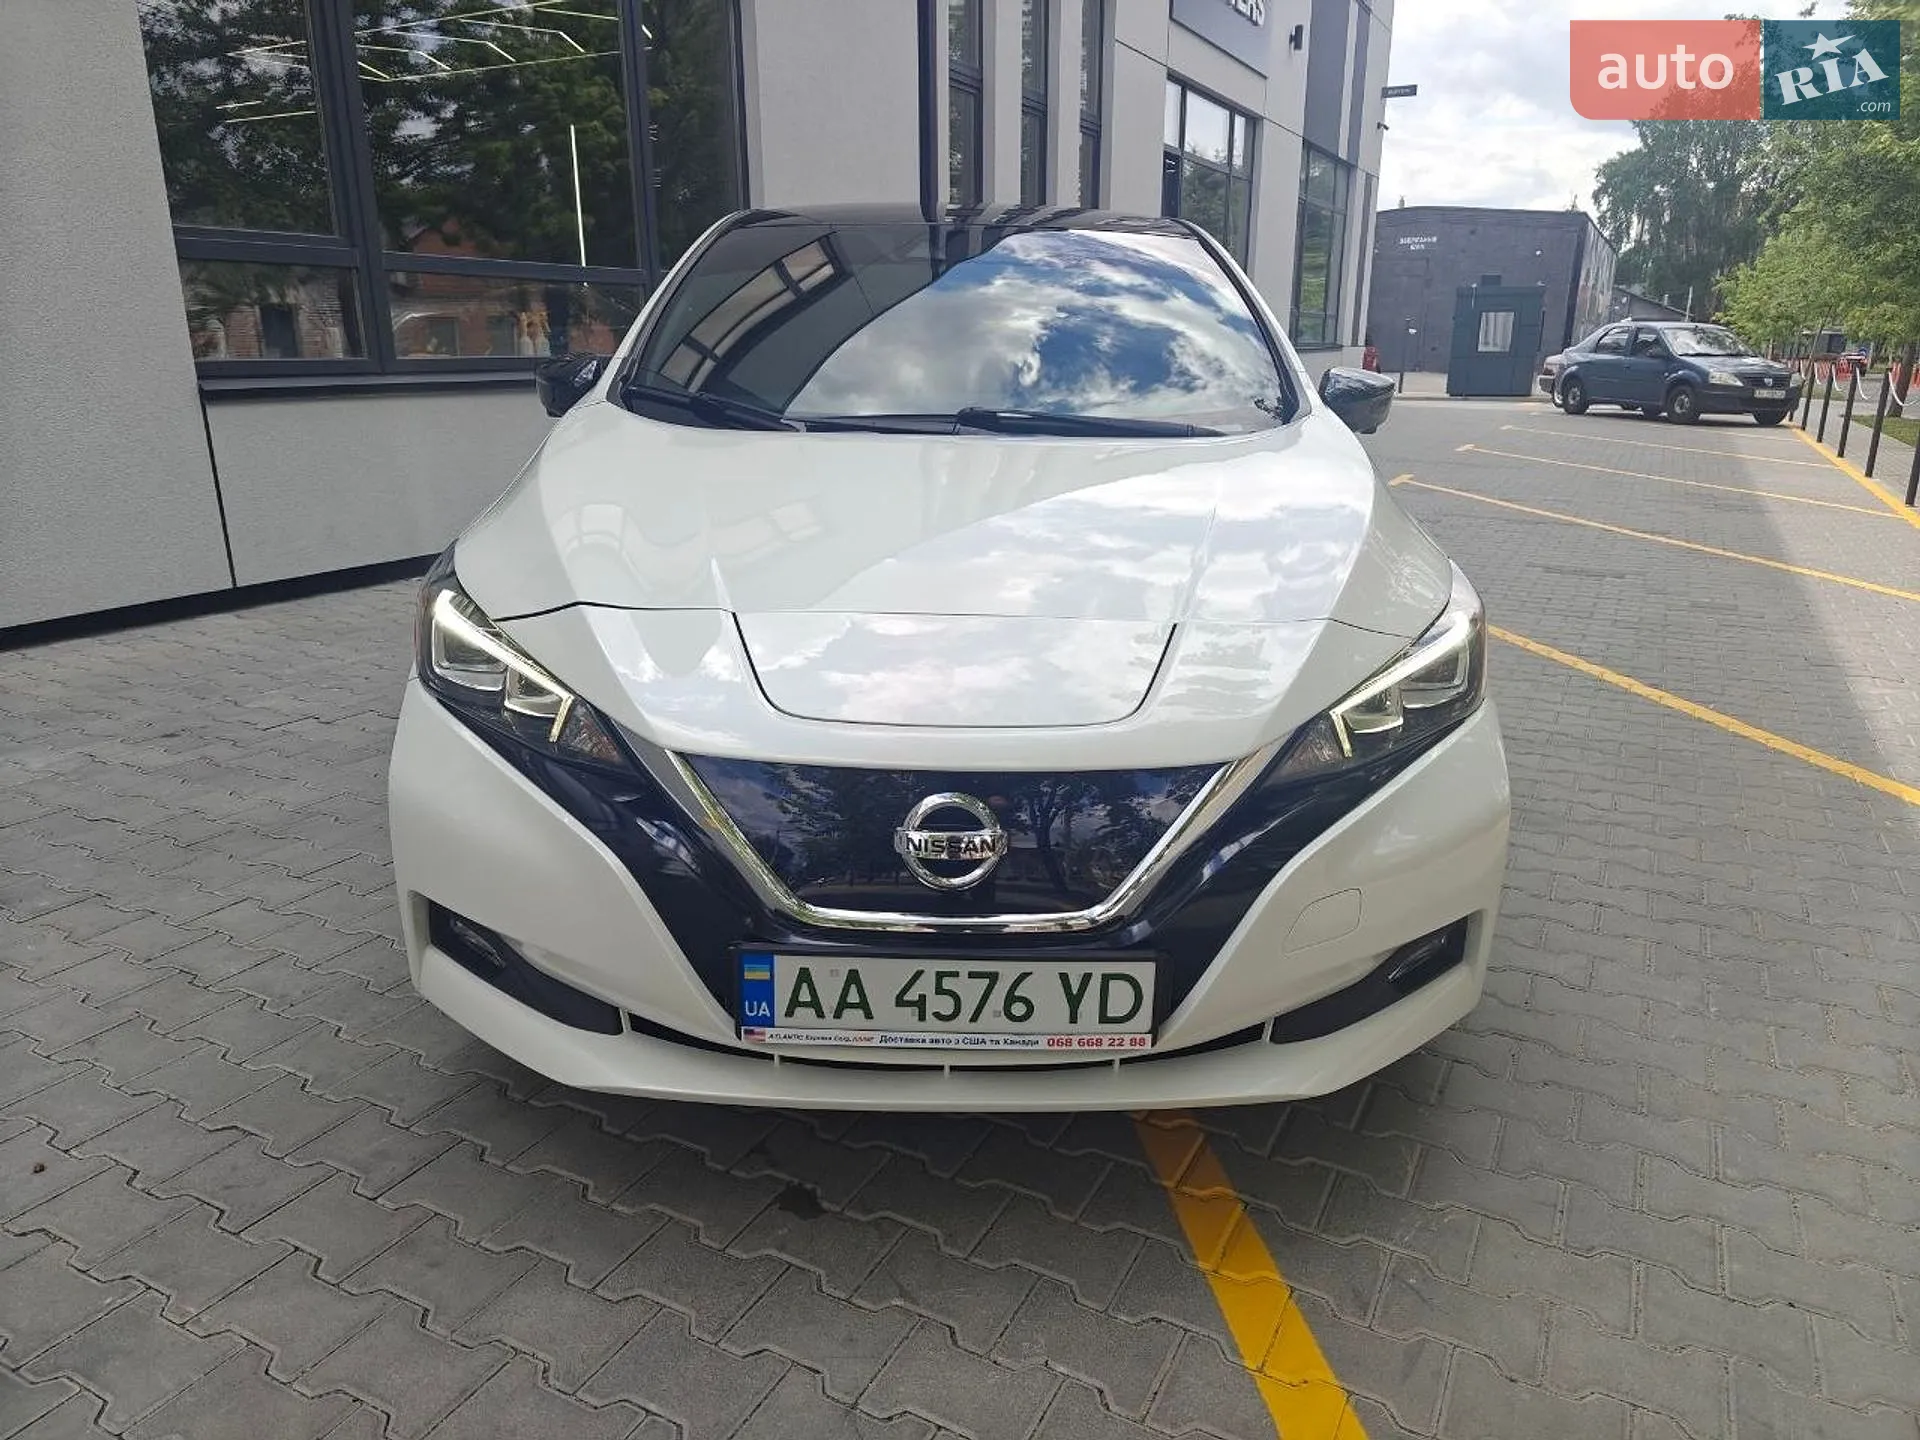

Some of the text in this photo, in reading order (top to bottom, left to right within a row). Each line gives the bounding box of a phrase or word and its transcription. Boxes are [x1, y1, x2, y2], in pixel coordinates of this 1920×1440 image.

[905, 833, 996, 853] NISSAN
[784, 967, 1144, 1025] AA 4576 YD
[745, 1001, 770, 1018] UA
[879, 1034, 927, 1044] Доставка
[929, 1037, 952, 1045] авто
[962, 1037, 987, 1046] США
[989, 1038, 1001, 1046] та
[1047, 1037, 1073, 1047] 068
[1077, 1038, 1103, 1047] 668
[1108, 1038, 1125, 1047] 22
